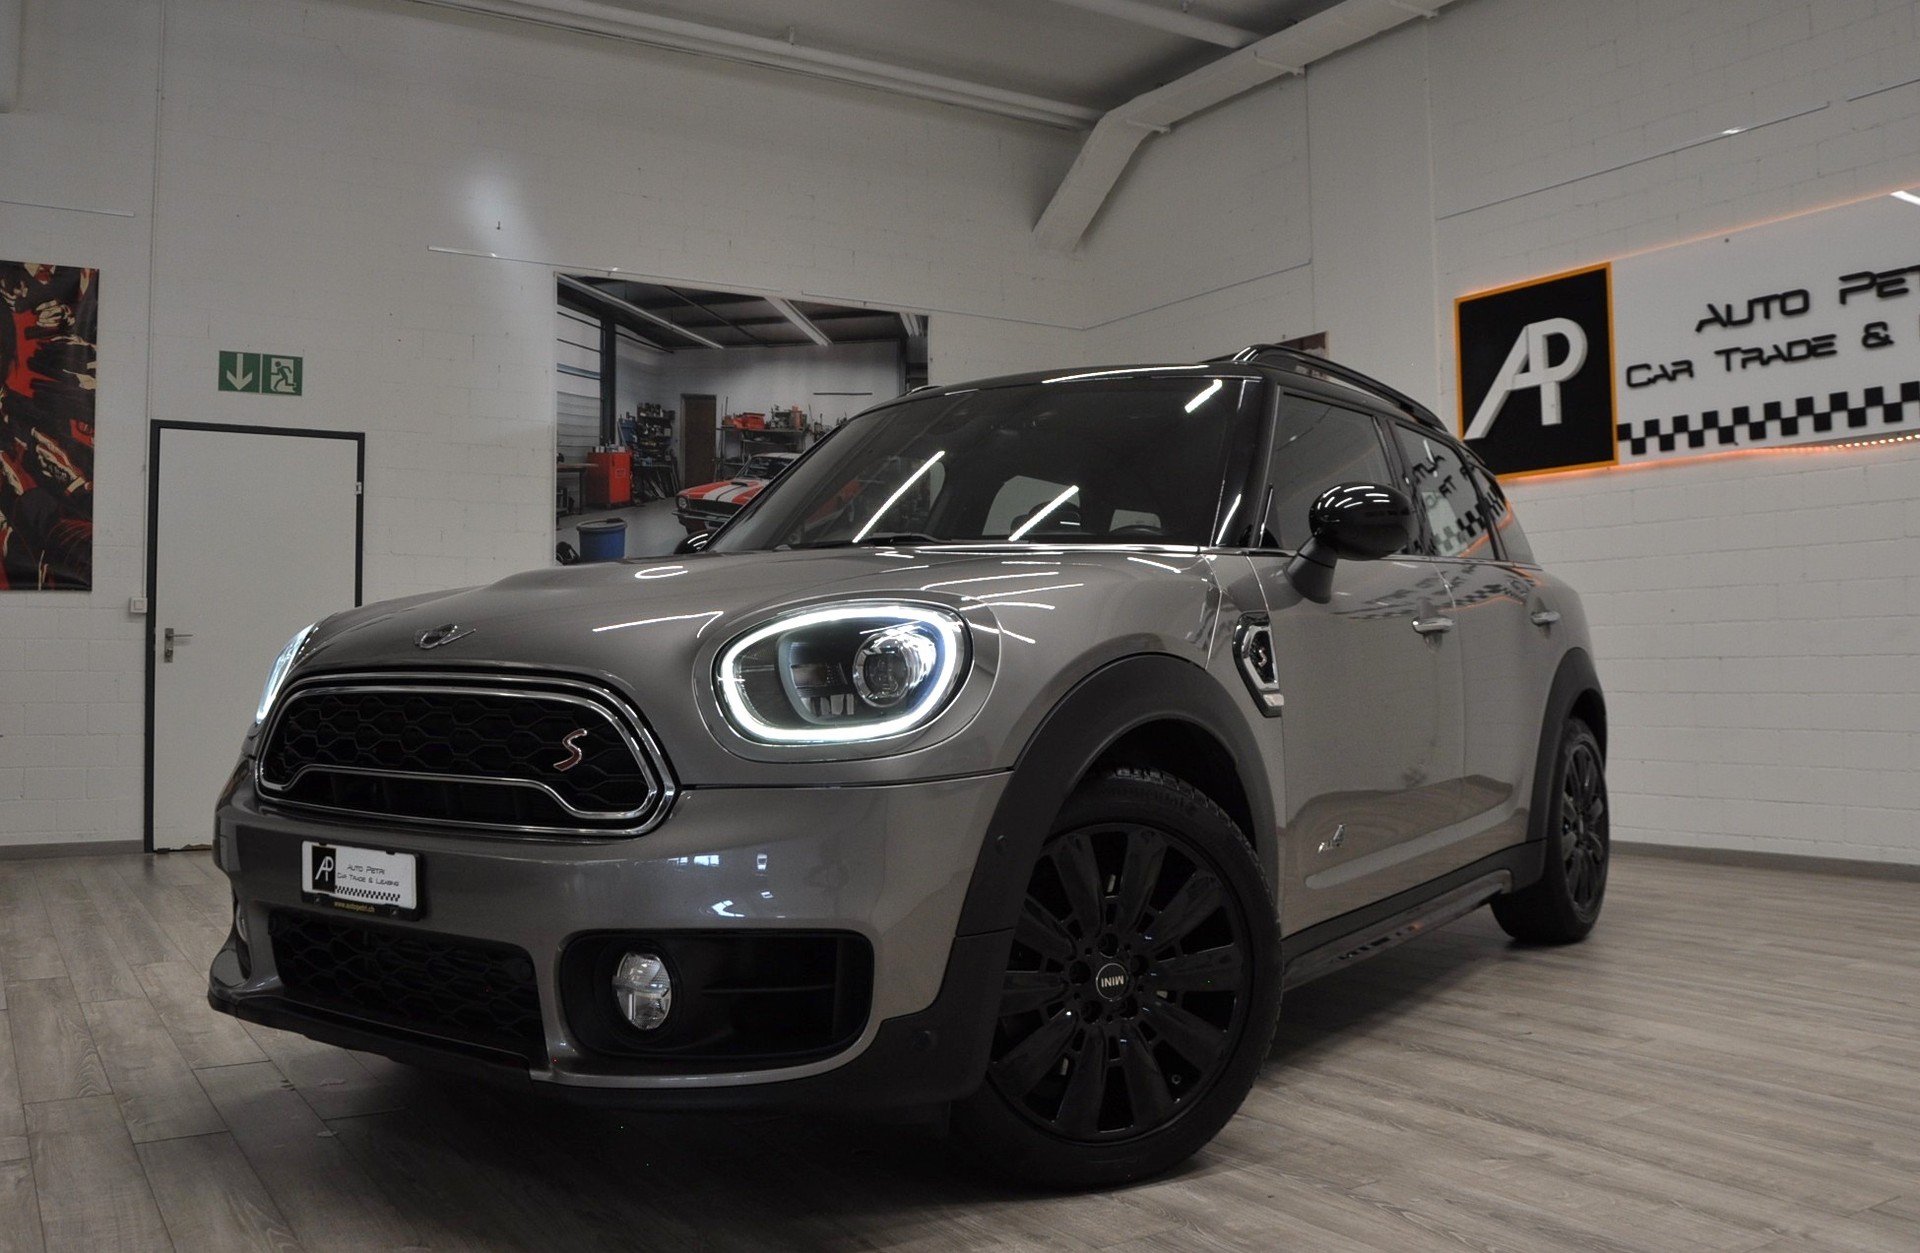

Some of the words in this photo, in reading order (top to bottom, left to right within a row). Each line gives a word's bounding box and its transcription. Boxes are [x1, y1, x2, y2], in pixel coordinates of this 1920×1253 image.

[1695, 289, 1809, 333] AUTO
[1626, 360, 1694, 388] CAR
[1714, 333, 1838, 372] TRADE
[1861, 321, 1895, 348] &
[553, 728, 588, 772] S
[1101, 975, 1124, 988] MINI
